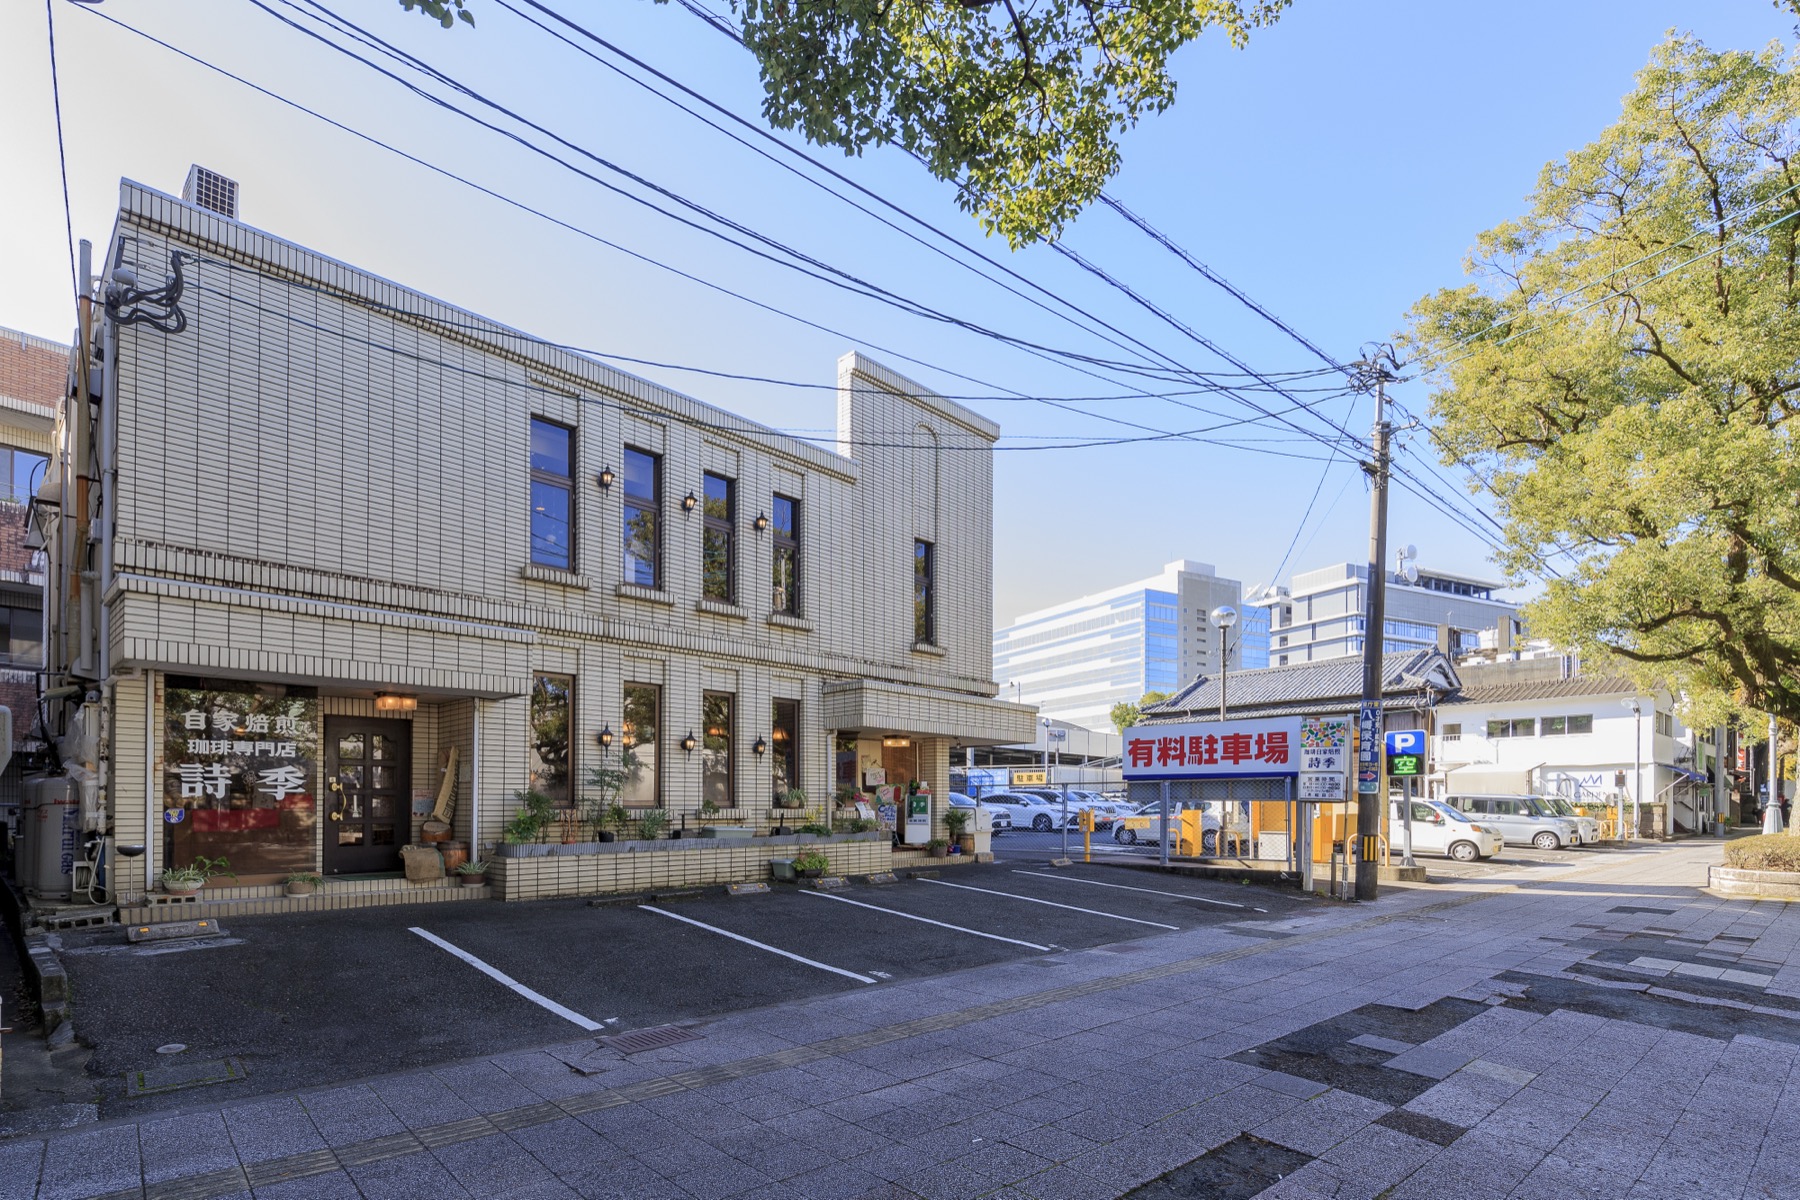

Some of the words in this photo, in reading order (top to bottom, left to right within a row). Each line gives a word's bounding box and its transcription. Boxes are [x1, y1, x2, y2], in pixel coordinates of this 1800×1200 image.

[182, 708, 301, 735] 自家焙煎
[1128, 731, 1289, 768] 有料駐車場
[1394, 733, 1415, 753] P
[1308, 757, 1336, 769] 詩季
[1394, 755, 1416, 774] 空
[179, 762, 307, 801] 詩季
[1016, 774, 1043, 783] 駐車場
